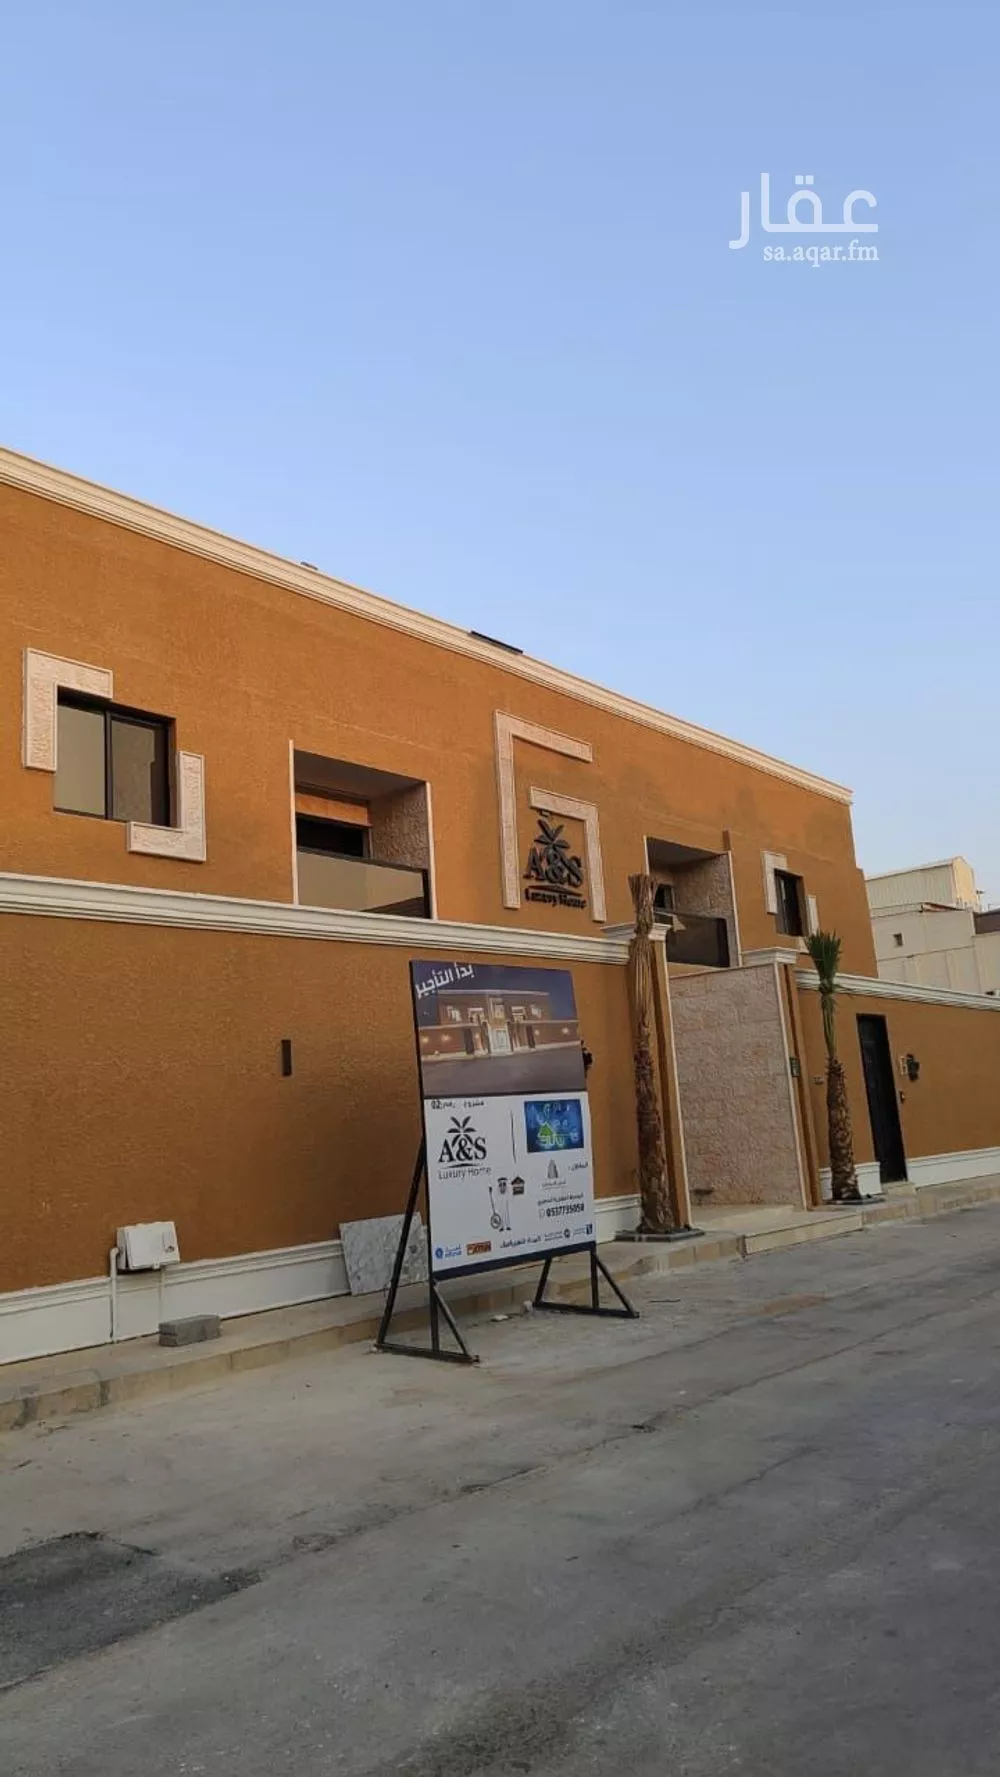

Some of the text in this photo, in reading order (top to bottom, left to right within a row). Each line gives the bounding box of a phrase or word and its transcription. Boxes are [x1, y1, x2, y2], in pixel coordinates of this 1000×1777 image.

[523, 846, 583, 888] A&S
[415, 962, 475, 999] بدأ التأجير
[438, 1137, 487, 1162] A&S
[438, 1167, 492, 1181] Luxury Home
